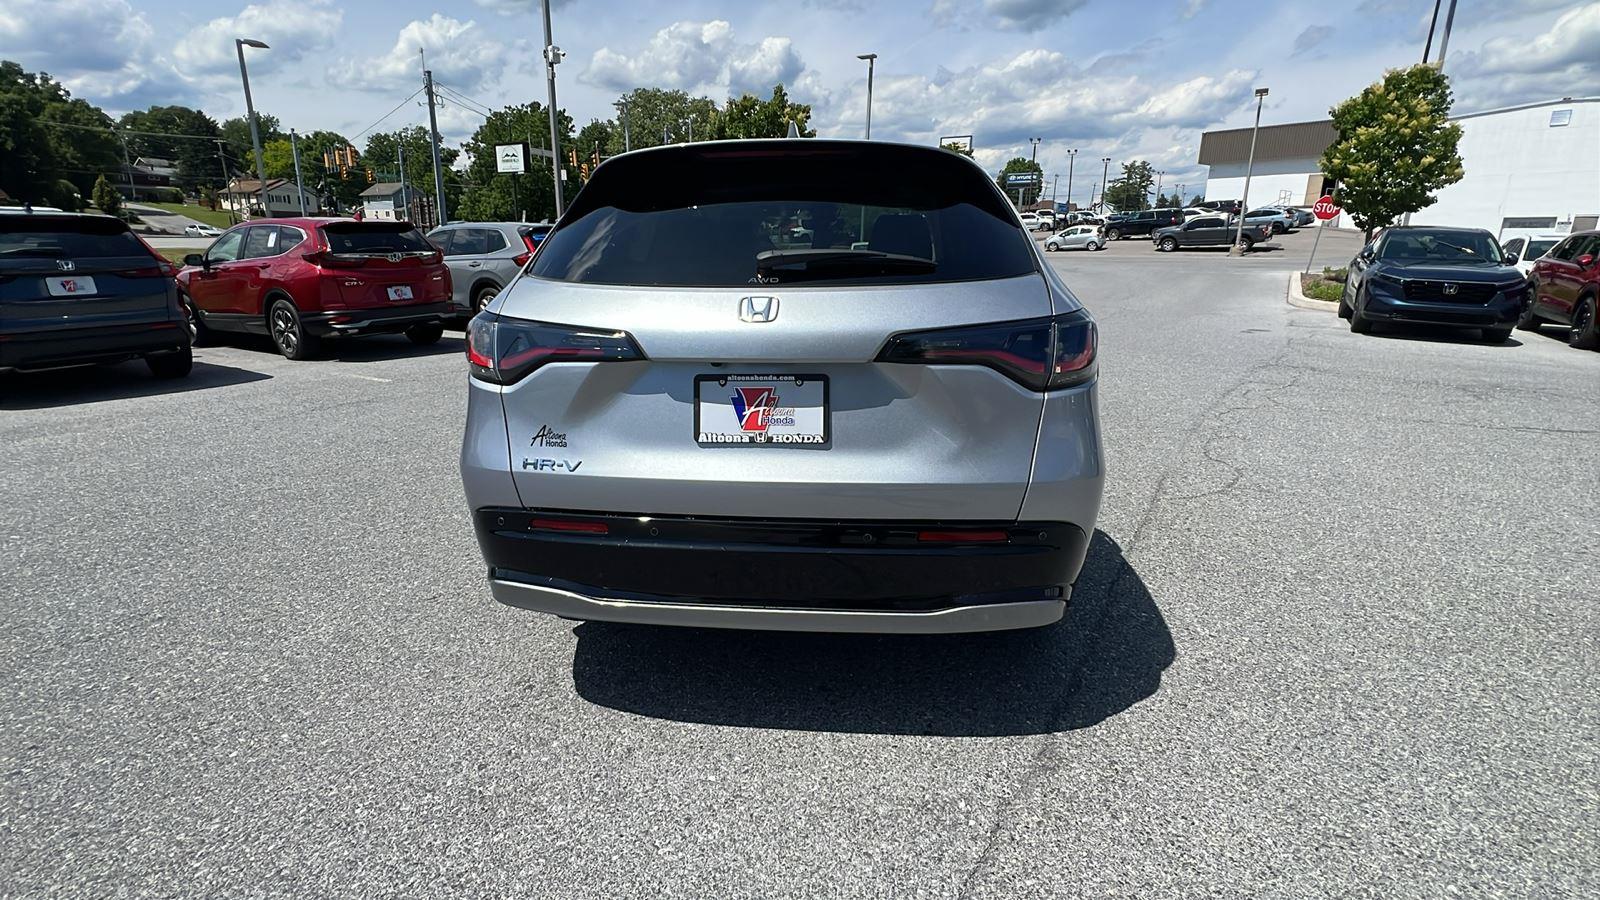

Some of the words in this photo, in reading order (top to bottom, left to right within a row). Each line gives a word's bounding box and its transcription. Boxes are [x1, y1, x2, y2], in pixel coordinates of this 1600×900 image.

[1315, 202, 1341, 214] STOP
[762, 415, 795, 426] Honda
[531, 424, 567, 447] Altoona
[698, 432, 750, 443] Altoona
[771, 434, 824, 443] HONDA
[522, 457, 583, 472] HR-V
